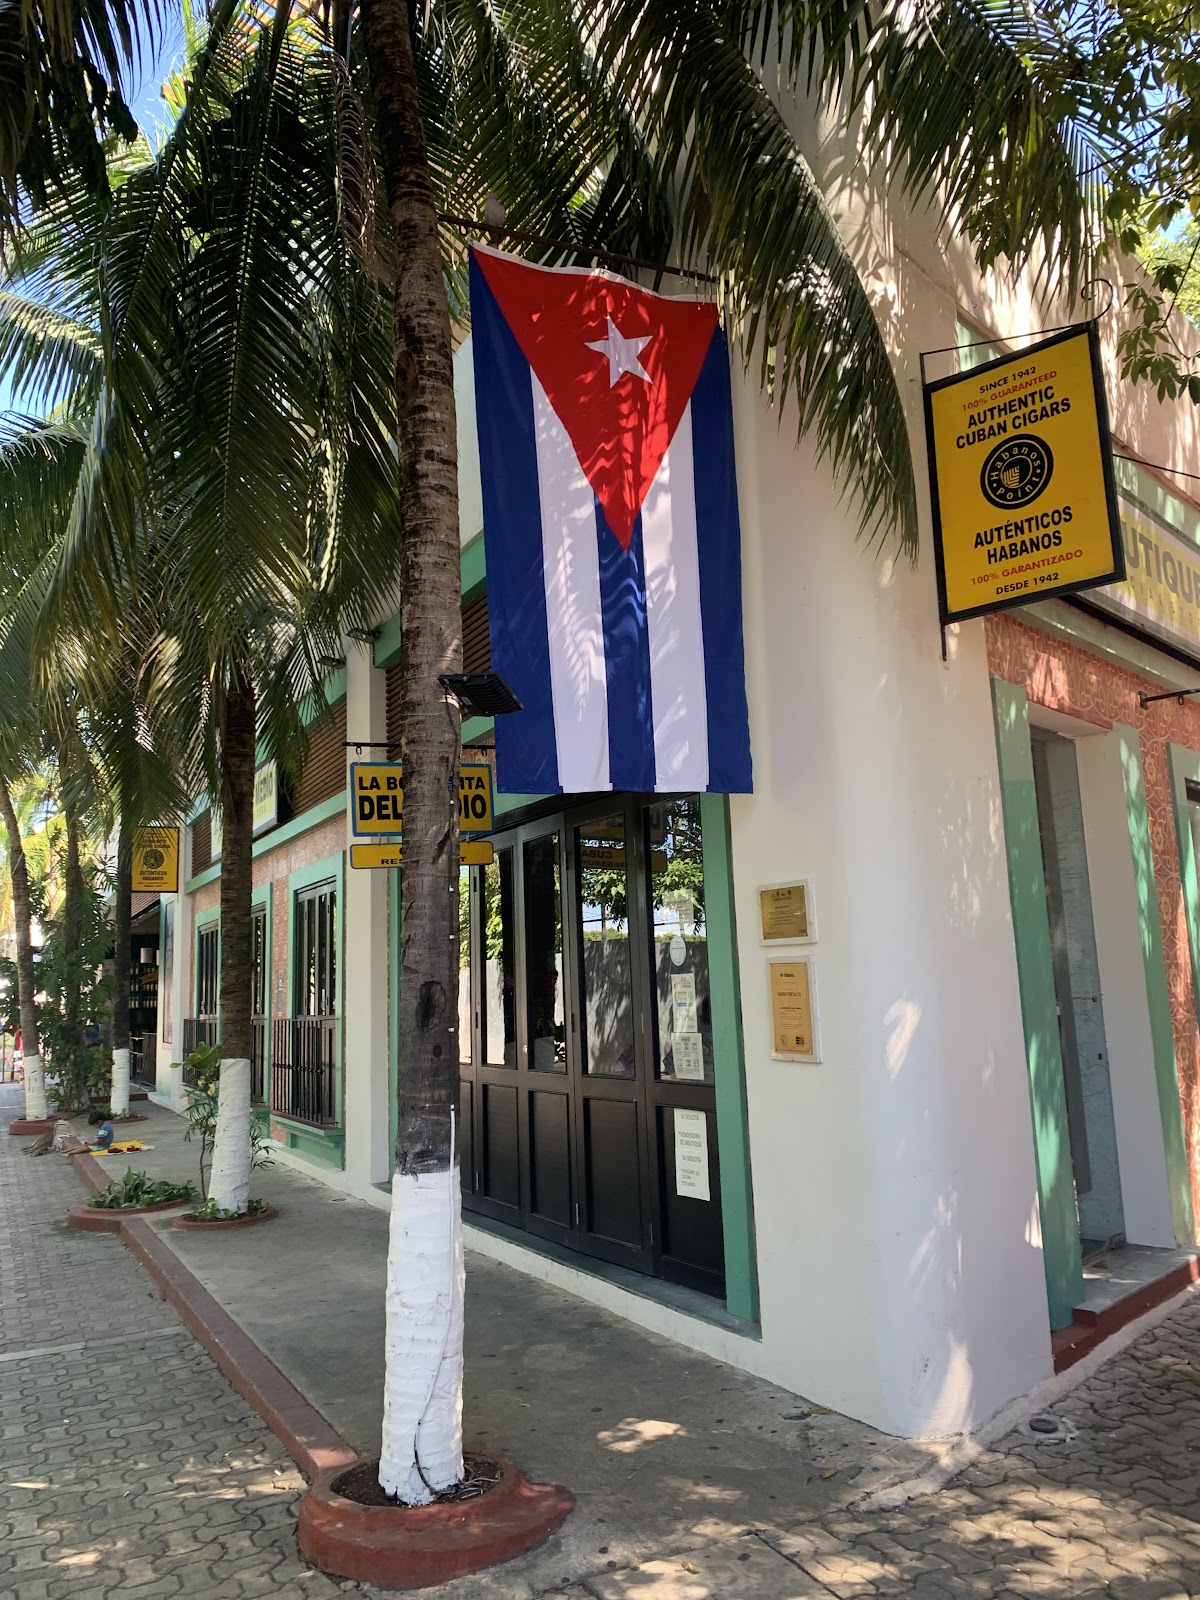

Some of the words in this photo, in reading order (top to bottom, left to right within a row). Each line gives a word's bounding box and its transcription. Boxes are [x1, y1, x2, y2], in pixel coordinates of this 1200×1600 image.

[962, 396, 988, 411] 100%
[990, 370, 1057, 401] GUARANTEED
[979, 376, 1009, 394] SINCE
[1012, 366, 1036, 381] 1942
[956, 420, 1008, 449] CUBAN
[1011, 397, 1071, 430] CIGARS
[967, 385, 1055, 429] AUTHENTIC
[990, 446, 1041, 480] Habanos
[996, 476, 1040, 500] Point
[974, 505, 1073, 549] AUTÉNTICOS
[987, 530, 1063, 565] HABANOS
[1121, 520, 1200, 608] UTIQUE
[971, 571, 999, 586] 100%
[1002, 549, 1083, 577] GARANTIZADO
[996, 579, 1030, 595] DESDE
[1033, 572, 1059, 586] 1942
[358, 776, 381, 791] LA
[358, 795, 403, 821] DEL
